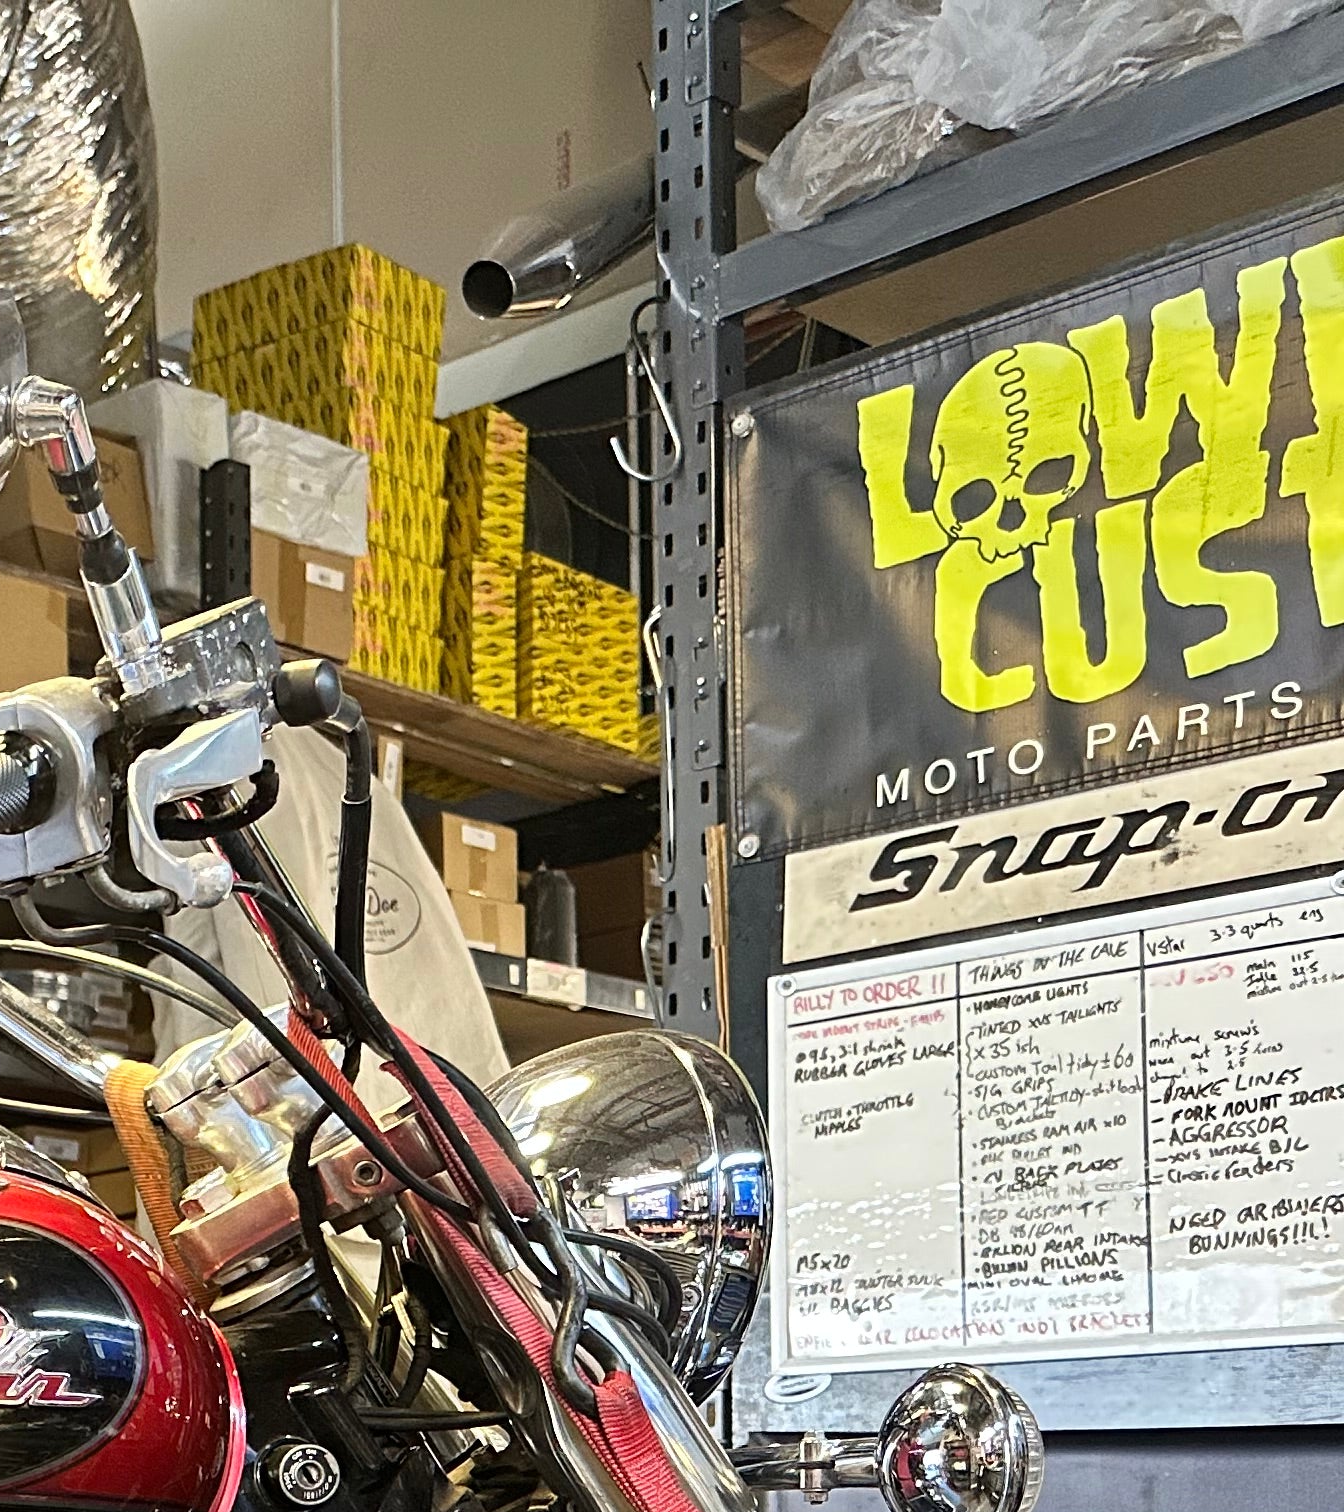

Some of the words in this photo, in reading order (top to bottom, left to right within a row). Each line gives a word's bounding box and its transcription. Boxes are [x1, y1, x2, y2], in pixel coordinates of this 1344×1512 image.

[876, 739, 1044, 807] MOTO
[1087, 681, 1304, 759] PARTS
[968, 960, 1023, 984] THINGS
[1058, 947, 1085, 968] THE
[1091, 941, 1129, 960] CAVE
[794, 990, 835, 1014] BILLY
[840, 988, 858, 1006] TO
[863, 975, 922, 1004] ORDER
[972, 1020, 1021, 1040] TINTED
[990, 1037, 1011, 1059] 35
[1016, 1035, 1041, 1055] ish
[854, 1050, 906, 1077] GLOVES
[1012, 1077, 1056, 1095] GRIPS
[1236, 1067, 1302, 1091] LINES
[1074, 1118, 1098, 1133] AIR
[1171, 1104, 1217, 1124] FORK
[1169, 1116, 1288, 1146] AGGRESSOR
[1041, 1249, 1119, 1273] PILLIONS
